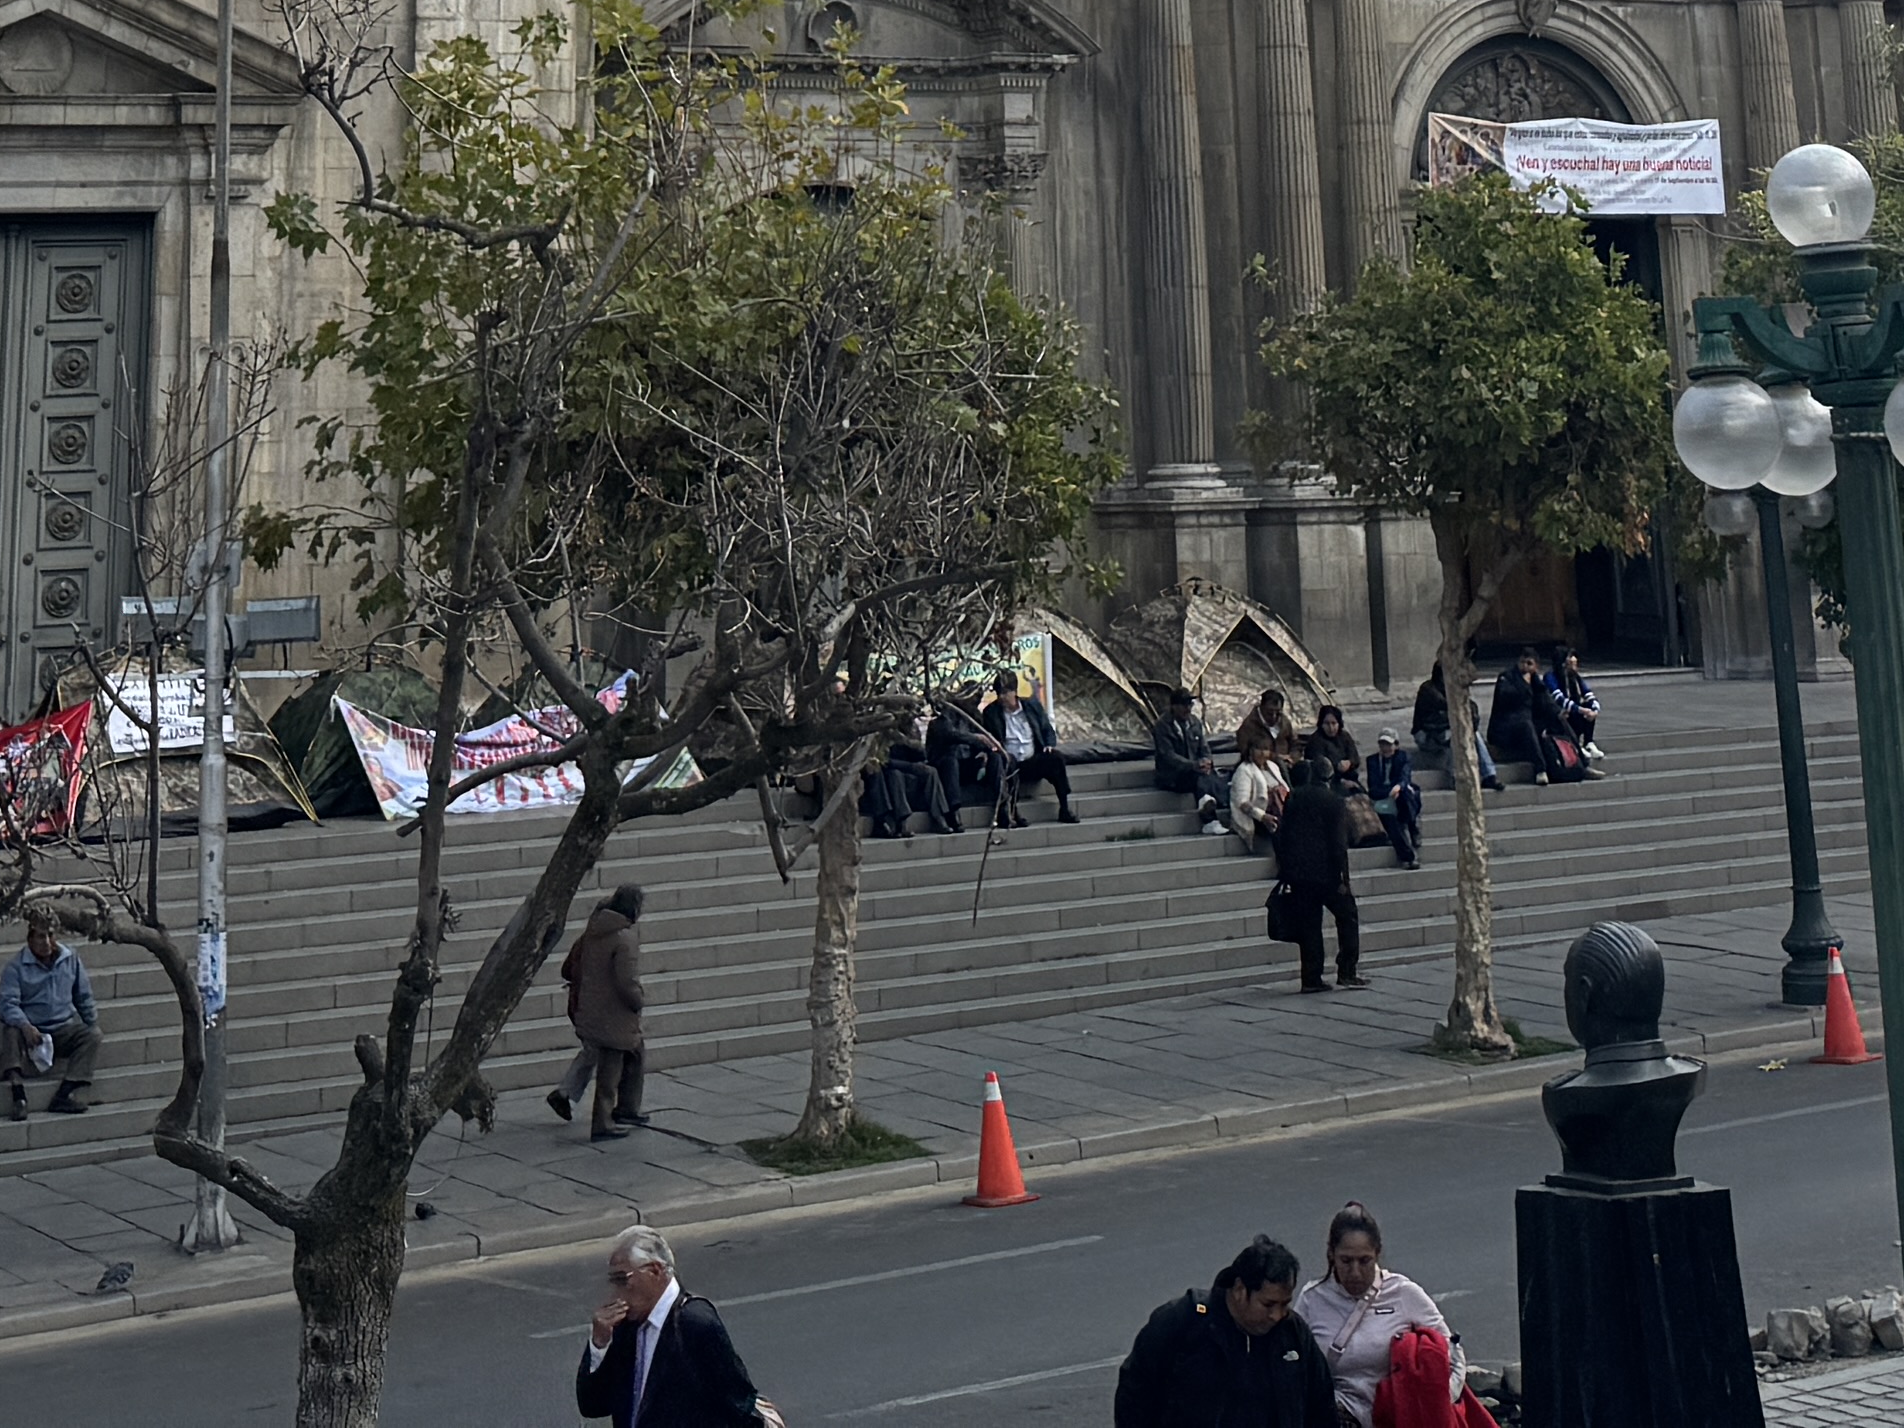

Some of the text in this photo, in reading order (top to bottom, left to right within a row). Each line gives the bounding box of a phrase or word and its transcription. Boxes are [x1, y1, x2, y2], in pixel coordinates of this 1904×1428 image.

[1516, 154, 1540, 172] ¡Ven
[1541, 158, 1548, 173] y
[1602, 156, 1621, 175] hay
[1623, 160, 1641, 172] una
[1643, 156, 1674, 172] buena
